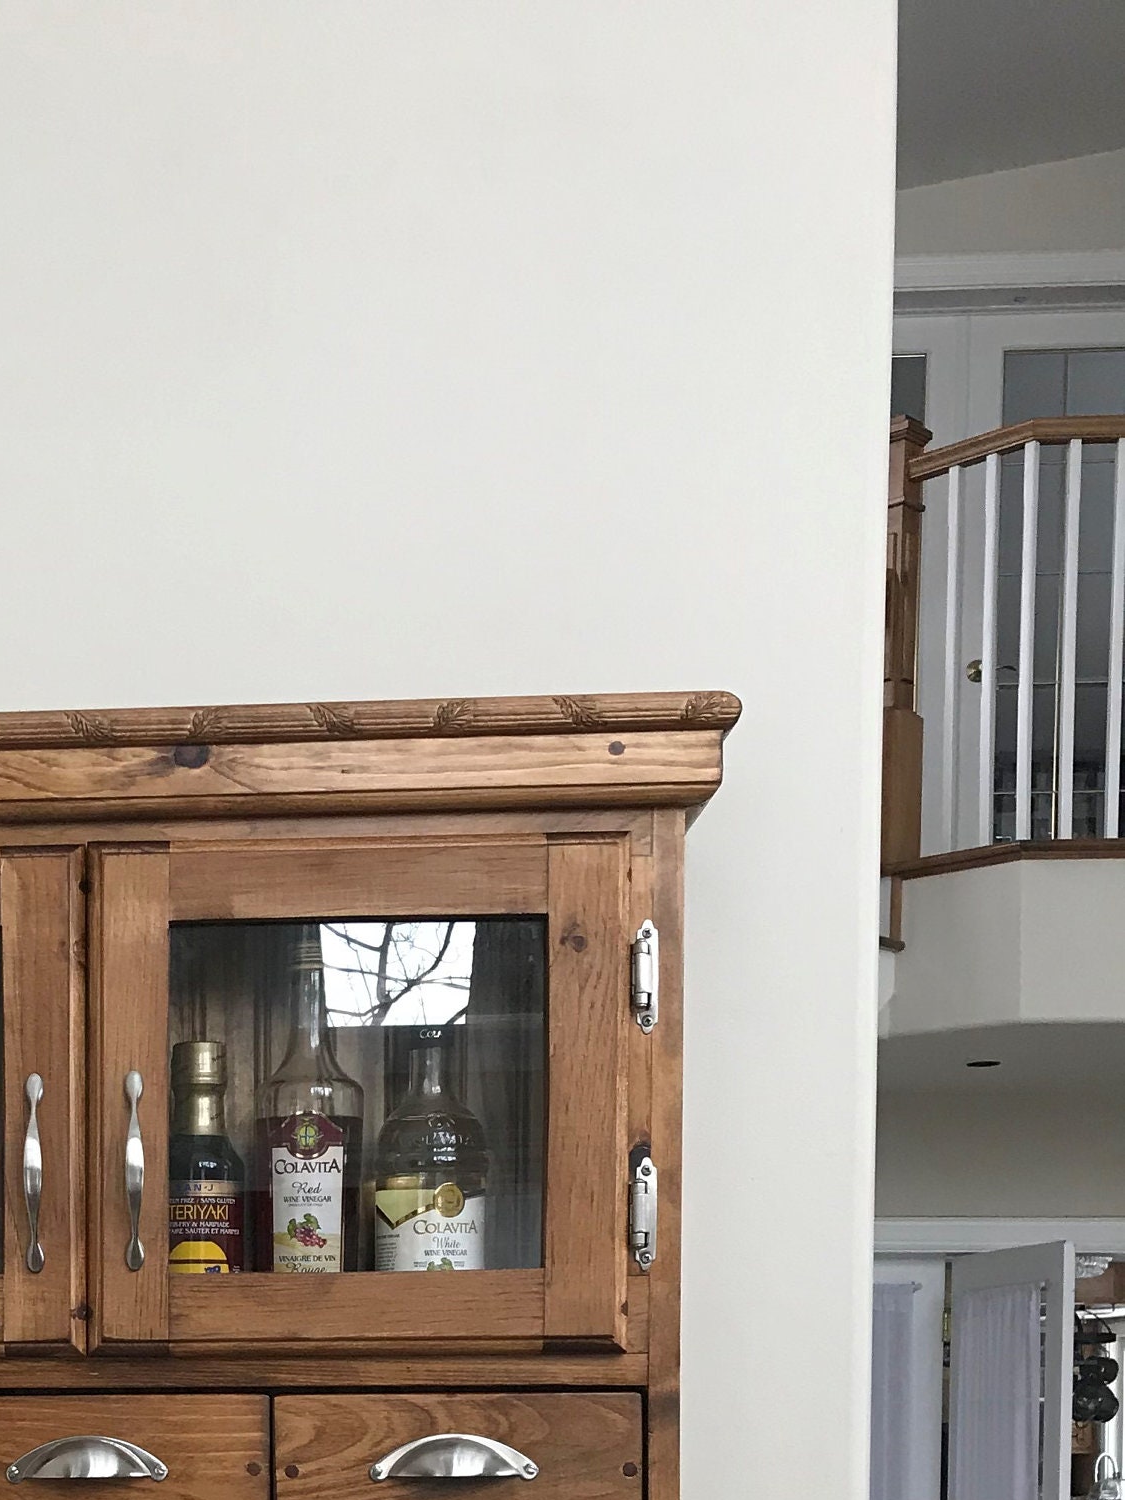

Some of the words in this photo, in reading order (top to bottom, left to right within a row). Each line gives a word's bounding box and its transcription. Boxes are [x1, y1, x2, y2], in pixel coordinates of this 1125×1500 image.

[274, 1158, 341, 1175] COLAVITA
[292, 1182, 322, 1194] Red
[169, 1204, 229, 1220] TERIYAKI
[413, 1219, 478, 1234] COLAVITA
[432, 1236, 461, 1249] White
